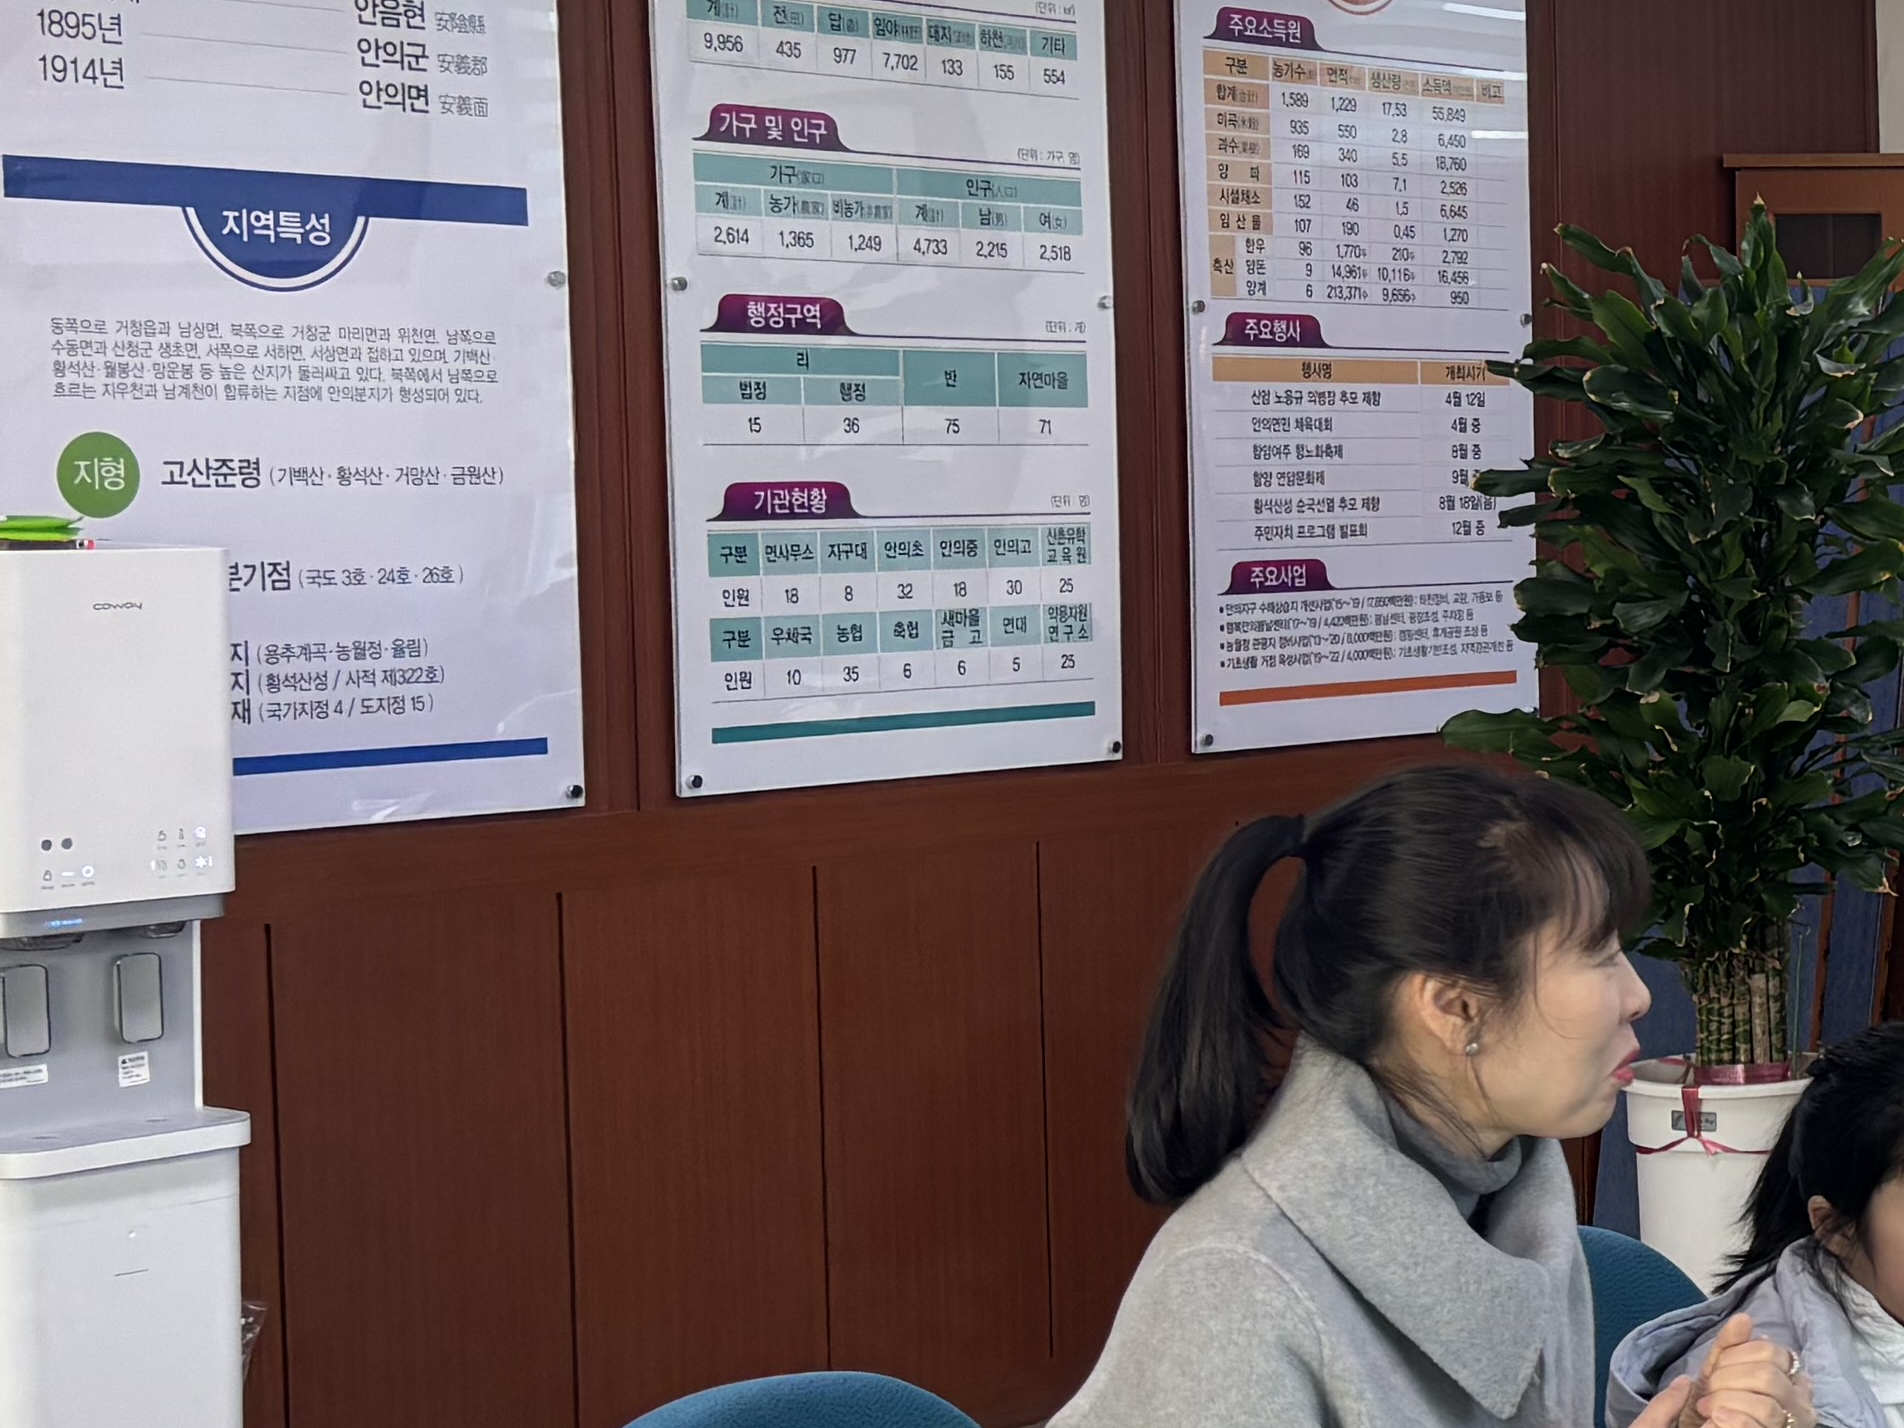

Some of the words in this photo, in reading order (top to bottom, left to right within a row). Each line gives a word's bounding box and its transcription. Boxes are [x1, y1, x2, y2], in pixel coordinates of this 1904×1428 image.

[1228, 13, 1302, 43] 주요소득원
[36, 8, 123, 45] 1895년
[357, 37, 429, 73] 안의군
[1041, 36, 1066, 56] 기타
[703, 32, 744, 53] 9,956
[775, 40, 802, 59] 435
[832, 47, 857, 65] 977
[882, 52, 919, 72] 7,702
[941, 58, 963, 76] 133
[993, 63, 1015, 81] 155
[1043, 68, 1066, 85] 554
[38, 54, 125, 90] 1914년
[359, 79, 430, 114] 안의면
[1281, 91, 1309, 109] 1,589
[719, 111, 757, 139] 가구
[764, 115, 783, 141] 및
[790, 117, 828, 144] 인구
[1289, 119, 1310, 135] 935
[1337, 124, 1358, 139] 550
[1338, 147, 1358, 164] 340
[1340, 173, 1359, 189] 103
[1293, 194, 1311, 210] 152
[222, 208, 331, 246] 지역특성
[1294, 218, 1312, 233] 107
[713, 226, 750, 245] 2,614
[778, 230, 815, 249] 1,365
[848, 234, 883, 253] 1,249
[912, 238, 948, 256] 4,733
[975, 240, 1008, 259] 2,215
[1039, 244, 1072, 262] 2,518
[50, 317, 108, 336] 동쪽으로
[747, 301, 822, 330] 행정구역
[1244, 319, 1301, 342] 주요행사
[50, 339, 107, 357] 수동면과
[206, 342, 260, 359] 서쪽으로
[367, 347, 404, 363] 접하고
[218, 362, 247, 381] 높은
[1018, 370, 1069, 390] 자연마을
[53, 381, 97, 400] 흐르는
[102, 382, 157, 401] 지우천과
[162, 383, 218, 401] 남계천이
[223, 383, 278, 402] 합류하는
[284, 385, 323, 402] 지점에
[327, 385, 394, 403] 안의분지가
[399, 386, 450, 404] 형성되어
[747, 417, 762, 433] 15
[842, 417, 861, 434] 36
[944, 418, 961, 434] 75
[1038, 418, 1052, 435] 71
[73, 457, 126, 491] 지형
[160, 456, 261, 490] 고산준령
[754, 487, 828, 514] 기관현황
[719, 545, 748, 564] 구분
[765, 543, 814, 563] 면사무소
[827, 542, 868, 561] 지구대
[993, 538, 1032, 556] 안의고
[1249, 564, 1307, 587] 주요사업
[722, 588, 750, 608] 인원
[784, 587, 799, 604] 18
[896, 583, 913, 600] 32
[953, 580, 968, 598] 18
[1006, 579, 1023, 596] 30
[1059, 577, 1074, 594] 25
[722, 629, 752, 649] 구분
[836, 623, 863, 643] 농협
[345, 668, 377, 689] 사적
[724, 670, 752, 692] 인원
[786, 669, 802, 686] 10
[842, 665, 860, 683] 35
[1012, 656, 1021, 673] 5
[333, 699, 344, 715] 4
[360, 695, 406, 716] 도지정
